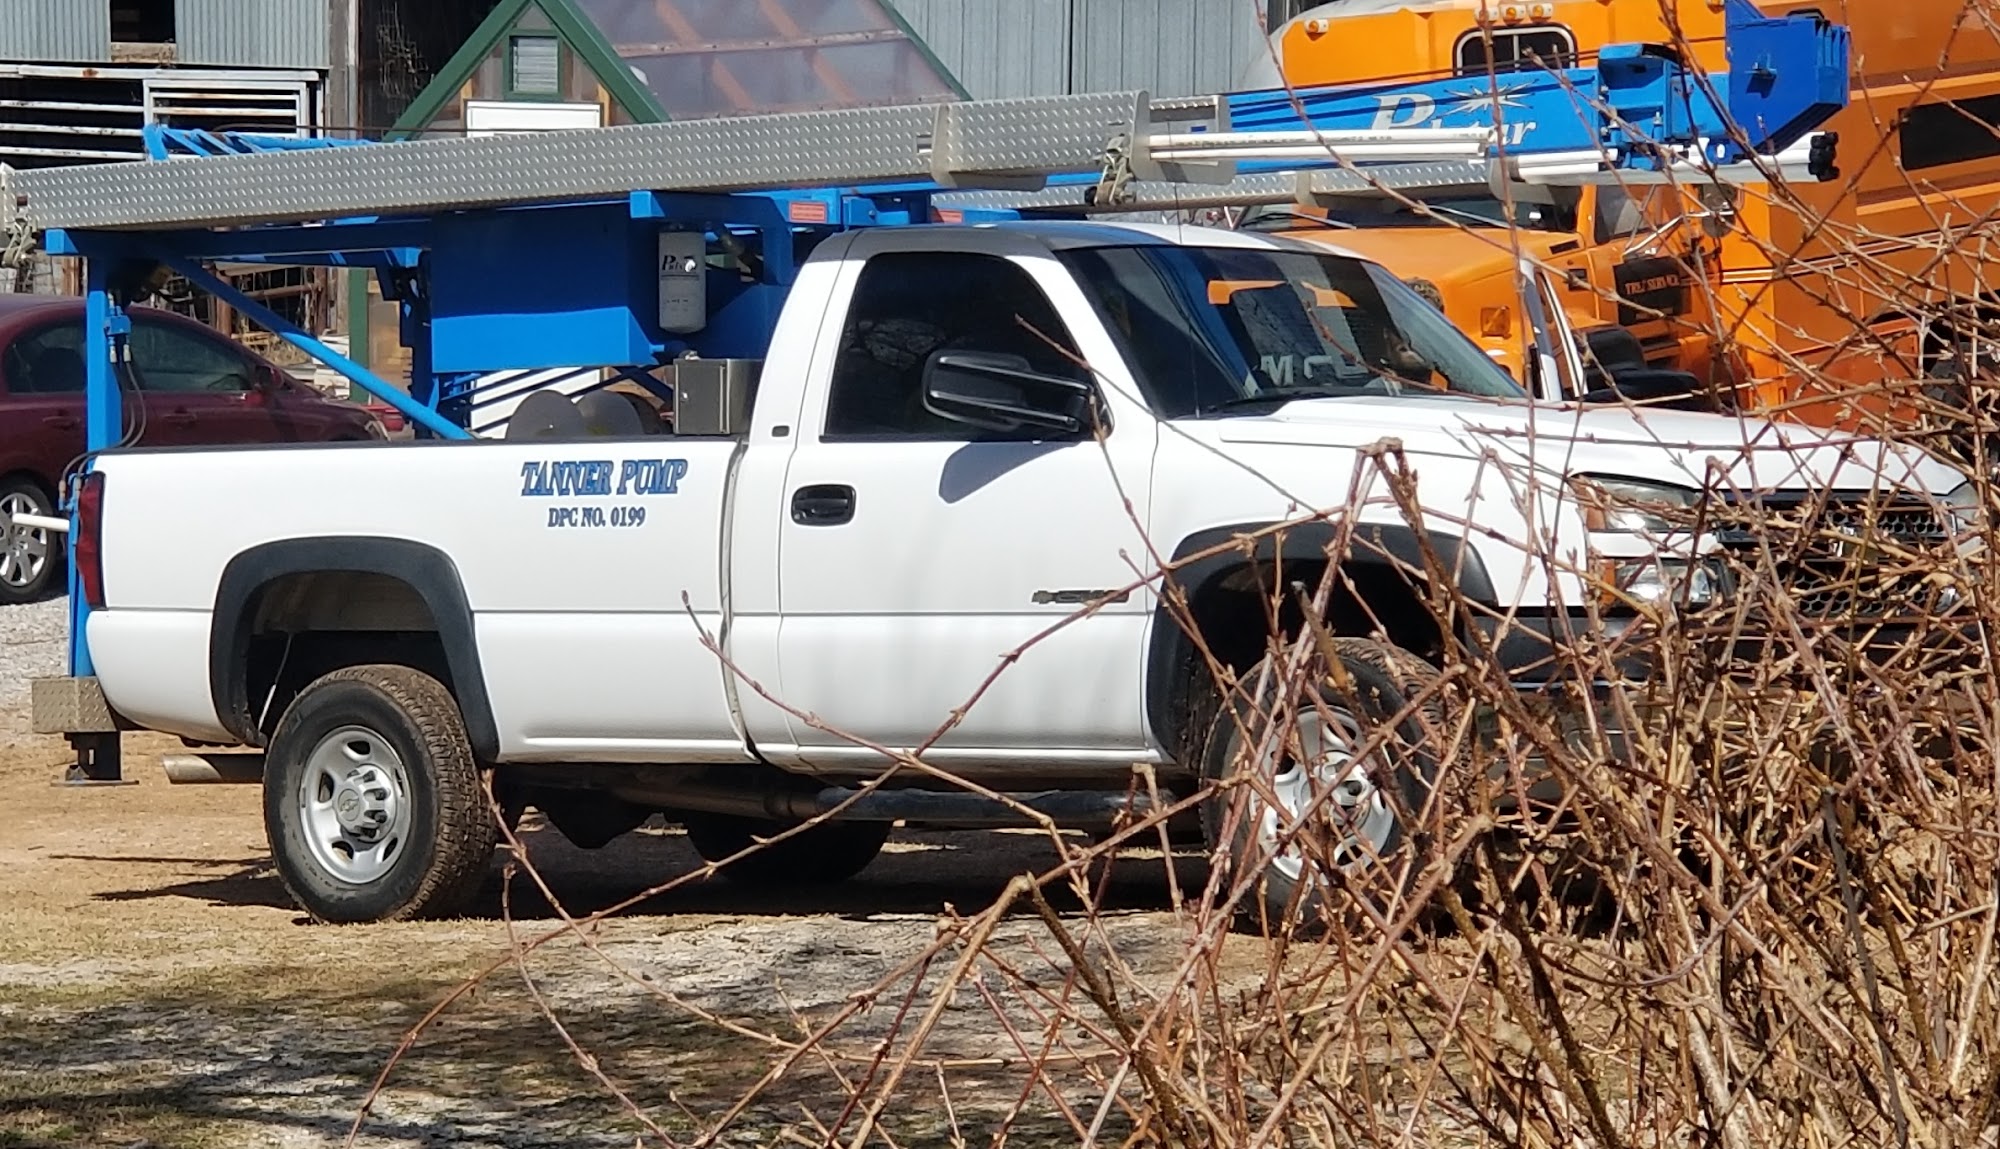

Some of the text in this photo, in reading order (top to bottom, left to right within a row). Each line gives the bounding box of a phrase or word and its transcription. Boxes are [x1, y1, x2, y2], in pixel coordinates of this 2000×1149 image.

[520, 458, 689, 496] TANNER PUMP
[547, 506, 646, 528] DPC NO. 0199
